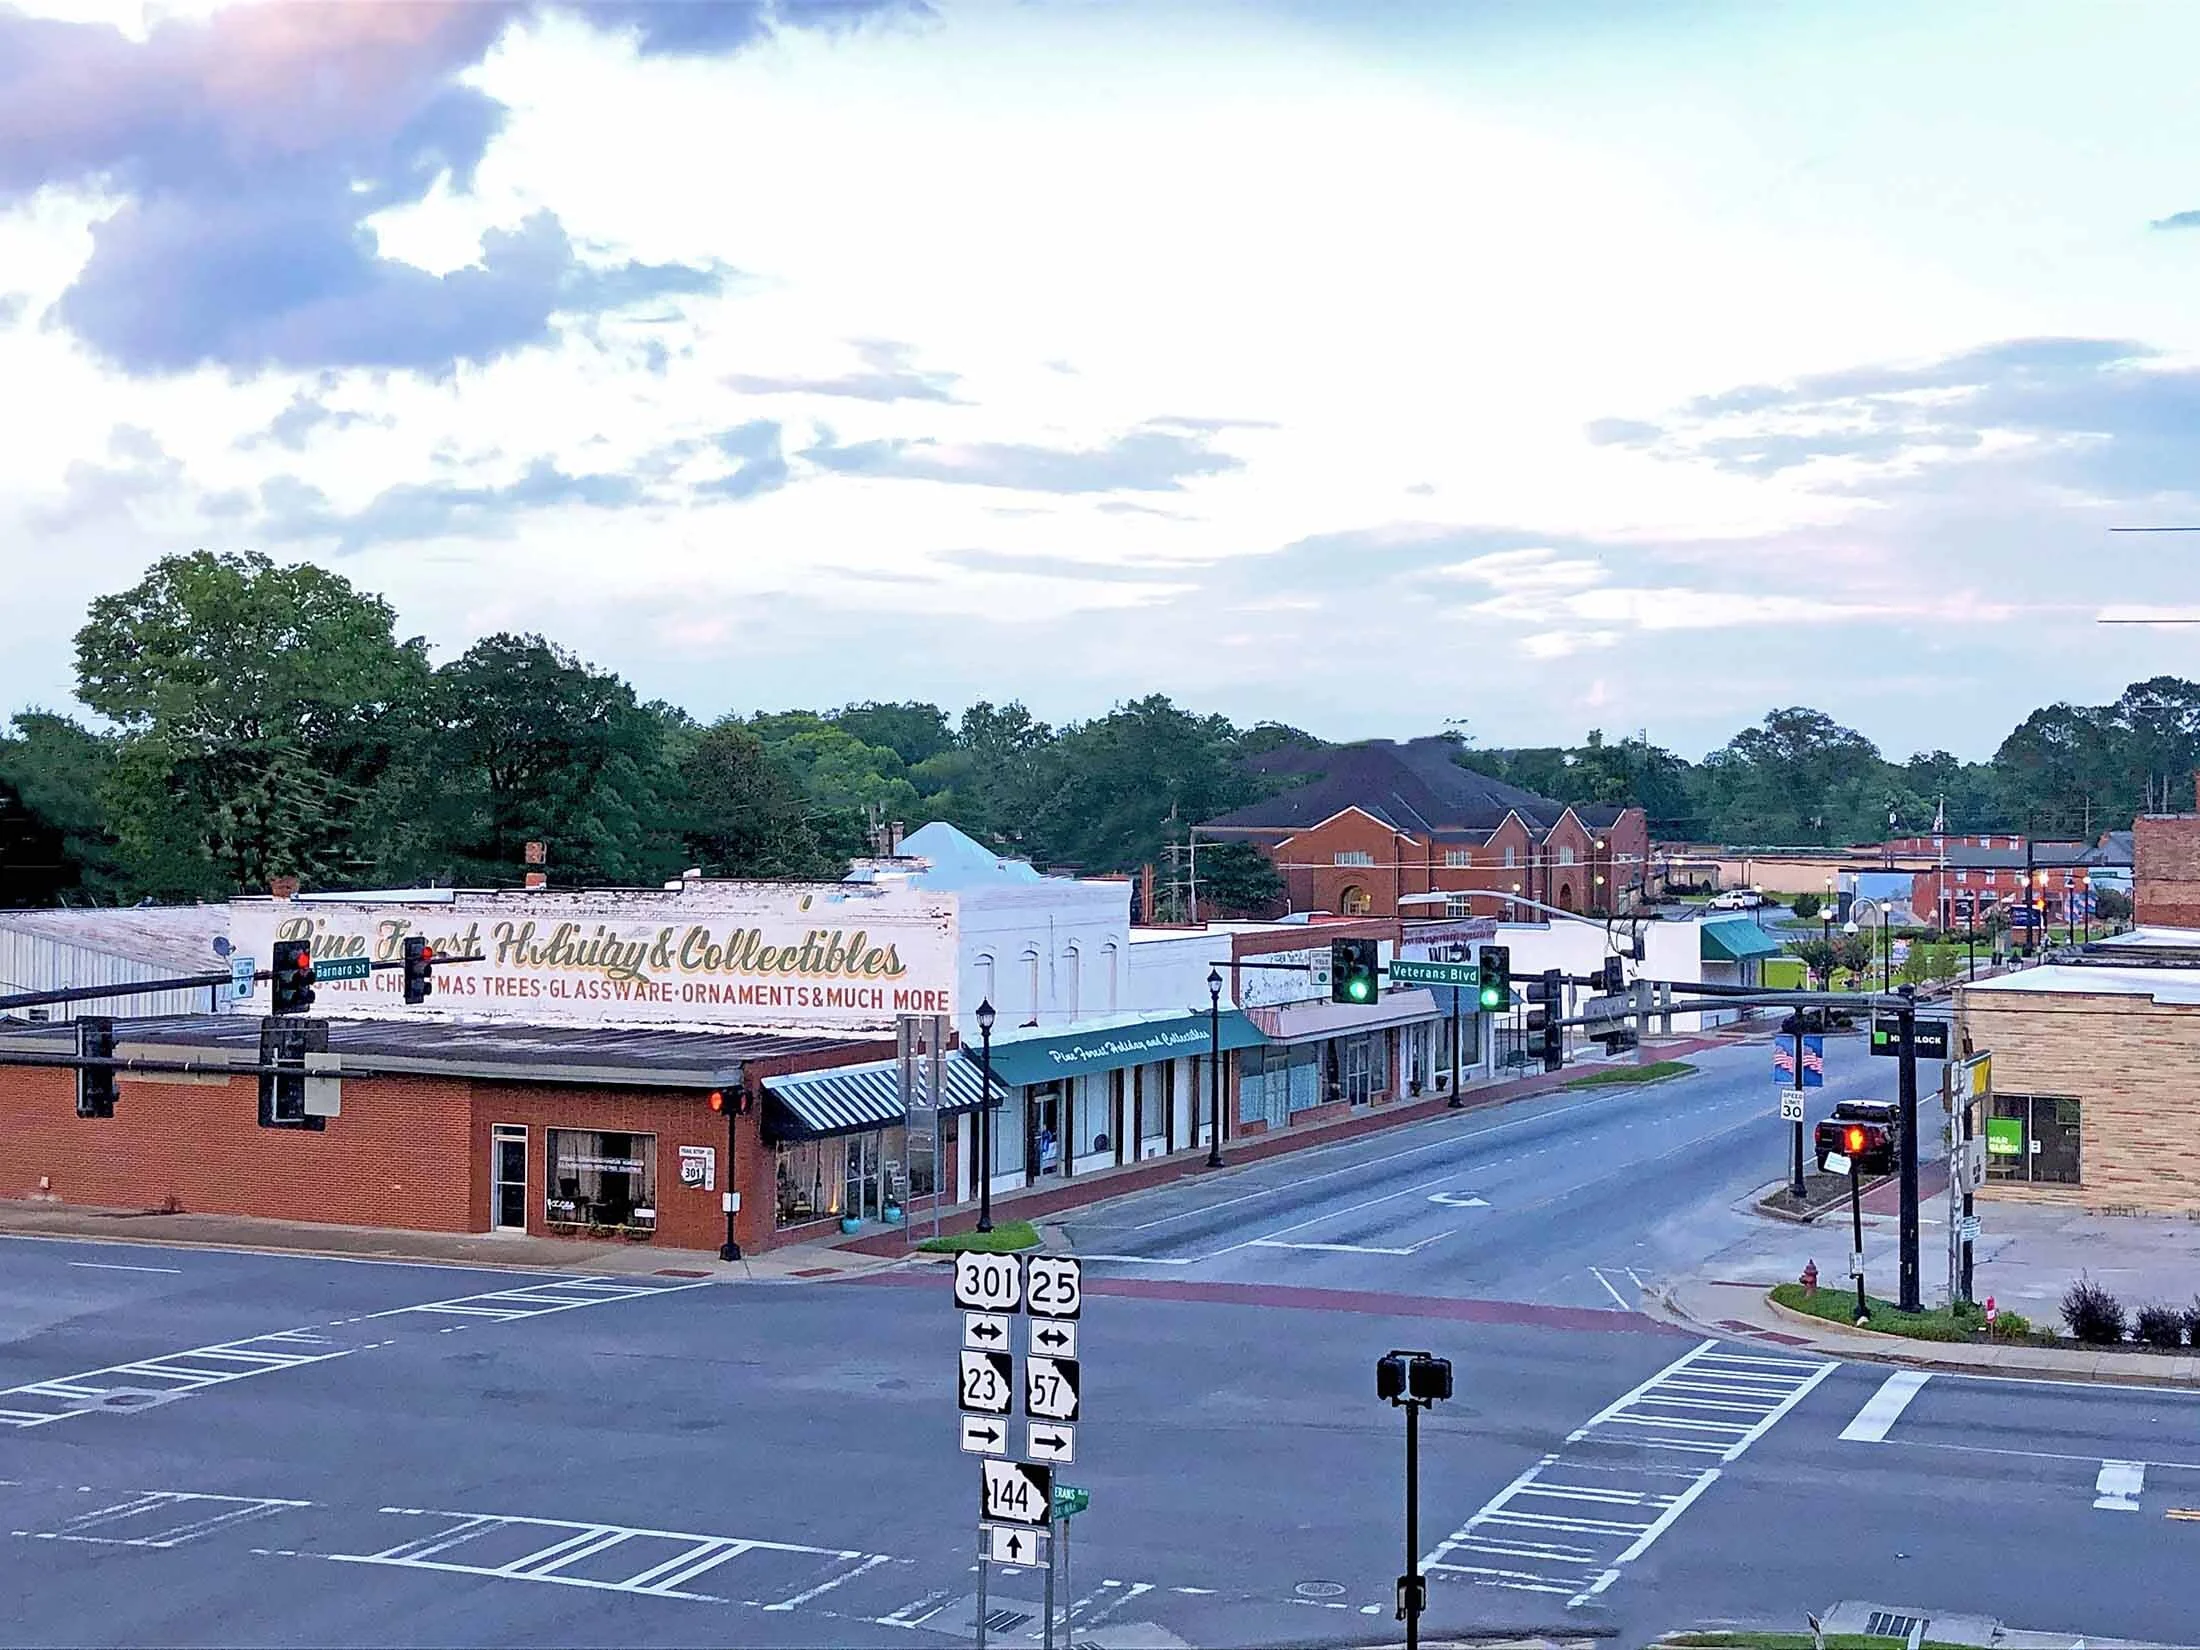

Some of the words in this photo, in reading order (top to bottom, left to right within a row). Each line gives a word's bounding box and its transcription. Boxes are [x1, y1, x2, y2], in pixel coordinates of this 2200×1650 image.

[679, 924, 907, 978] Collectibles
[316, 963, 352, 978] Barnard
[355, 962, 366, 974] St
[1393, 964, 1446, 980] Veterans
[1450, 968, 1478, 983] Blvd
[893, 988, 949, 1012] MORE
[1783, 1104, 1802, 1118] 30
[684, 1167, 700, 1179] 301
[964, 1264, 1012, 1299] 301
[1032, 1271, 1076, 1304] 25
[967, 1368, 996, 1401] 23
[1034, 1374, 1060, 1407] 57
[991, 1478, 1029, 1513] 144
